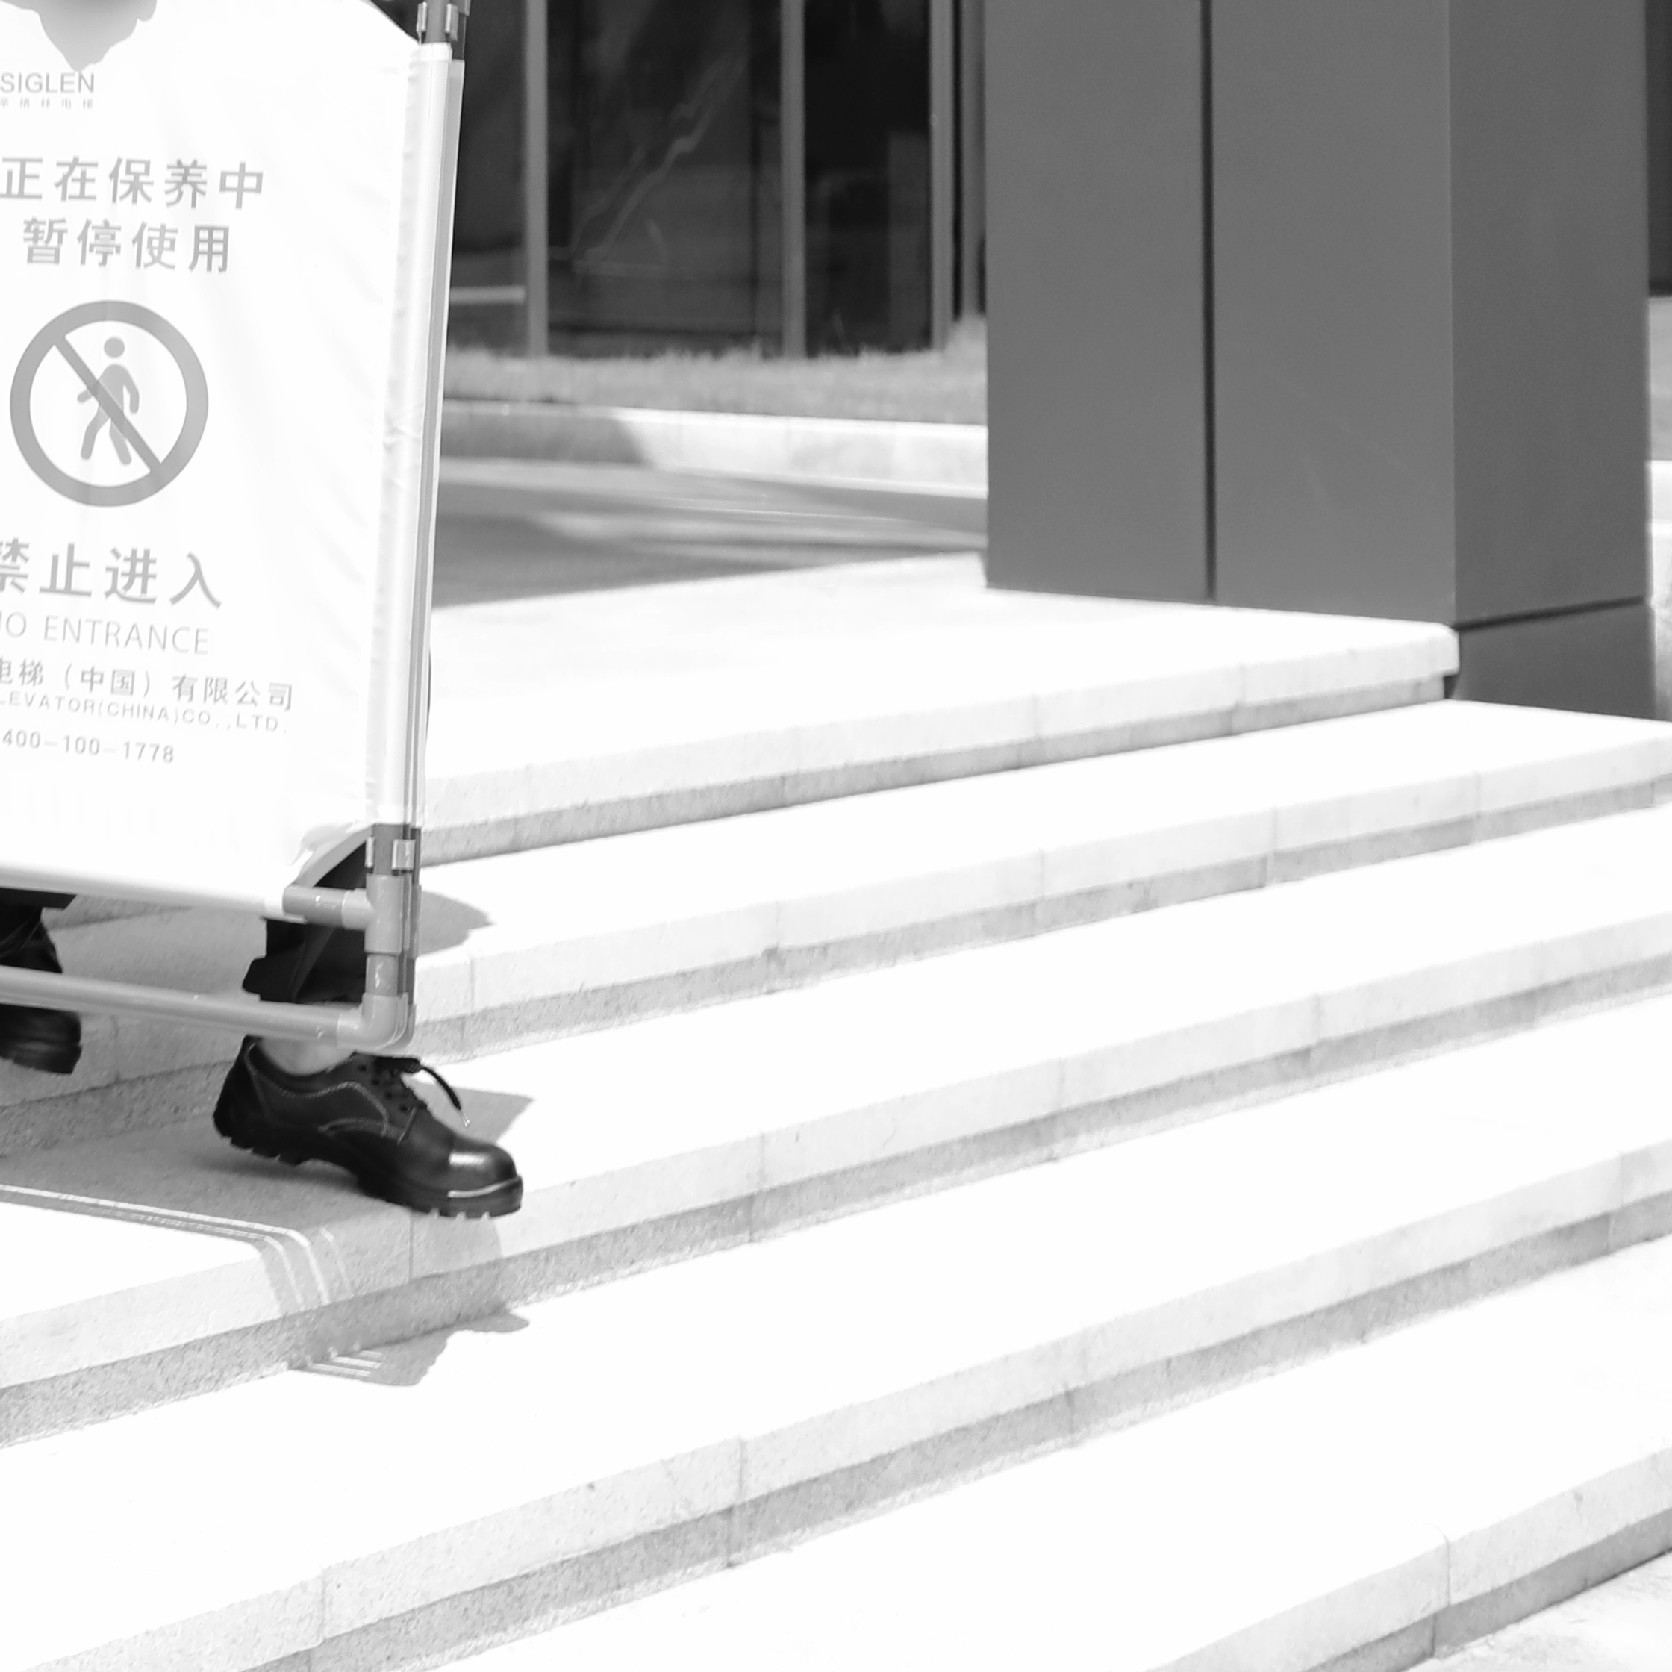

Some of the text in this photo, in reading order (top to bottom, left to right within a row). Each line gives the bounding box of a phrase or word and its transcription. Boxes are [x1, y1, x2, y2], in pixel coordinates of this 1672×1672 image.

[0, 71, 96, 94] SIGLEN
[22, 216, 231, 273] 暂停使用
[44, 615, 210, 656] ENTRANCE
[2, 728, 175, 764] 400-100-1778
